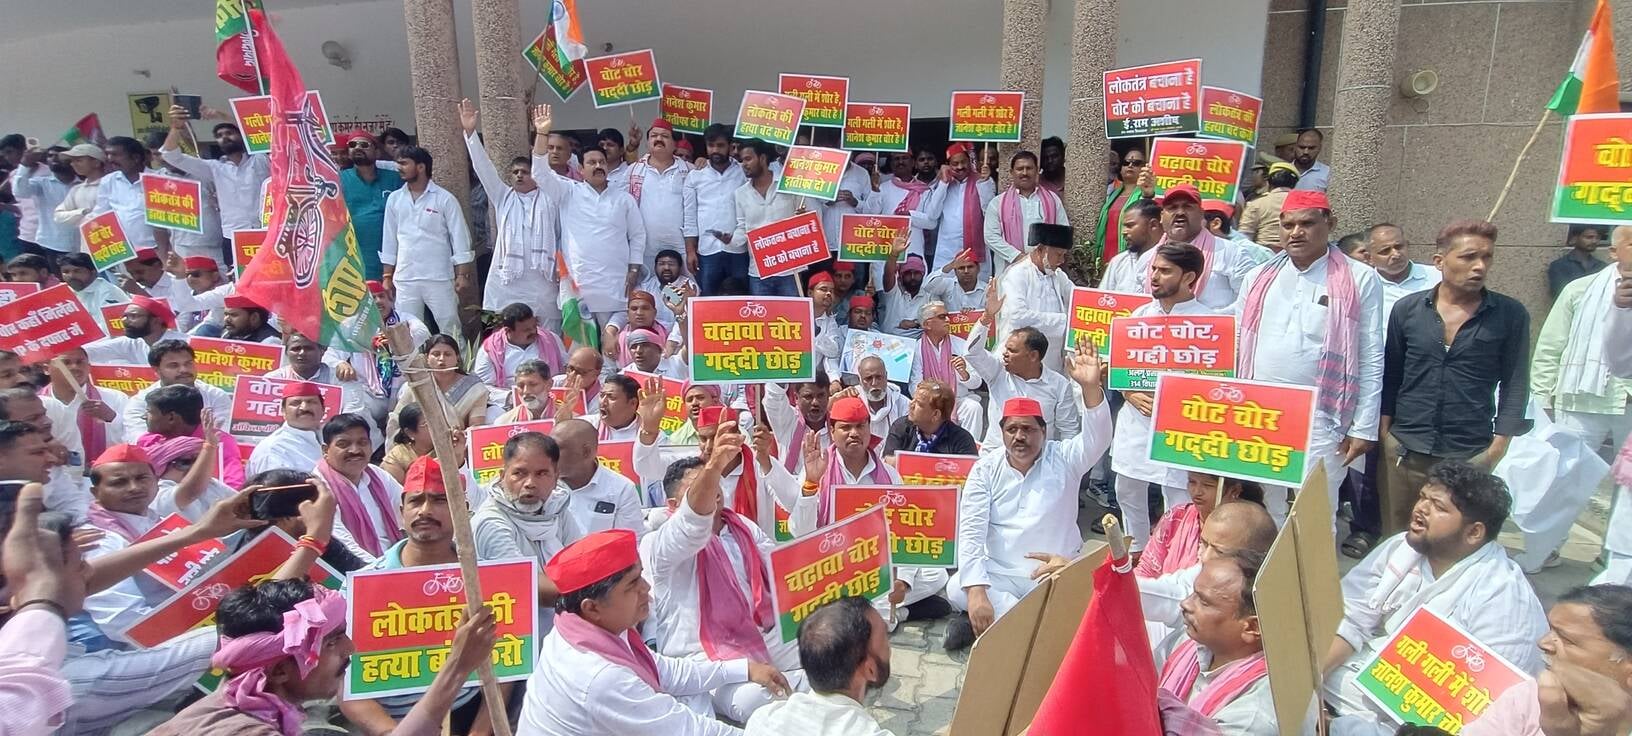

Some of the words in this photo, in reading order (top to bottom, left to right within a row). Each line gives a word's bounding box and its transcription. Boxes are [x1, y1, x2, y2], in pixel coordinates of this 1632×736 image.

[600, 68, 621, 80] वोट
[622, 64, 642, 78] चोर
[1108, 74, 1148, 94] लोकतंत्र
[1184, 68, 1194, 85] है
[598, 82, 629, 99] गद्दी
[630, 80, 652, 94] छोड़
[1111, 99, 1130, 116] वोट
[1131, 96, 1146, 114] को
[1146, 96, 1180, 112] बचाना
[1180, 92, 1192, 110] है
[780, 110, 794, 124] की
[774, 126, 791, 140] करो
[1594, 137, 1632, 168] वो
[814, 161, 840, 176] कुमार
[1160, 156, 1204, 172] चढ़ावा
[1206, 156, 1233, 174] चोर
[814, 179, 824, 192] दो
[1198, 176, 1228, 198] छोड़
[854, 226, 874, 238] वोट
[763, 255, 777, 268] वोट
[776, 250, 788, 263] को
[846, 243, 877, 256] गद्दी
[878, 244, 893, 256] छो
[1076, 306, 1114, 326] चढ़ावा
[702, 321, 764, 346] चढ़ावा
[768, 317, 802, 341] चोर
[1126, 322, 1166, 340] वोट
[1169, 320, 1220, 342] चोर,
[194, 350, 234, 366] ज्ञानेश
[237, 356, 276, 373] कुमार
[705, 348, 760, 377] गद्दी
[762, 349, 802, 374] छोड़
[1126, 346, 1168, 364] गद्दी
[1171, 346, 1219, 367] छोड़
[1182, 394, 1228, 424] वोट
[1232, 401, 1282, 431] चोर
[1165, 430, 1233, 460] गद्दी
[1236, 436, 1294, 472] छोड़
[898, 504, 936, 526] चोर
[904, 532, 946, 558] छोड़
[784, 551, 844, 592] चढ़ावा
[847, 535, 880, 564] चोर
[844, 567, 880, 597] छोड़
[360, 650, 422, 683] हत्या
[1396, 635, 1429, 666] गली
[1420, 653, 1456, 687] गली
[1400, 684, 1446, 724] कुमार
